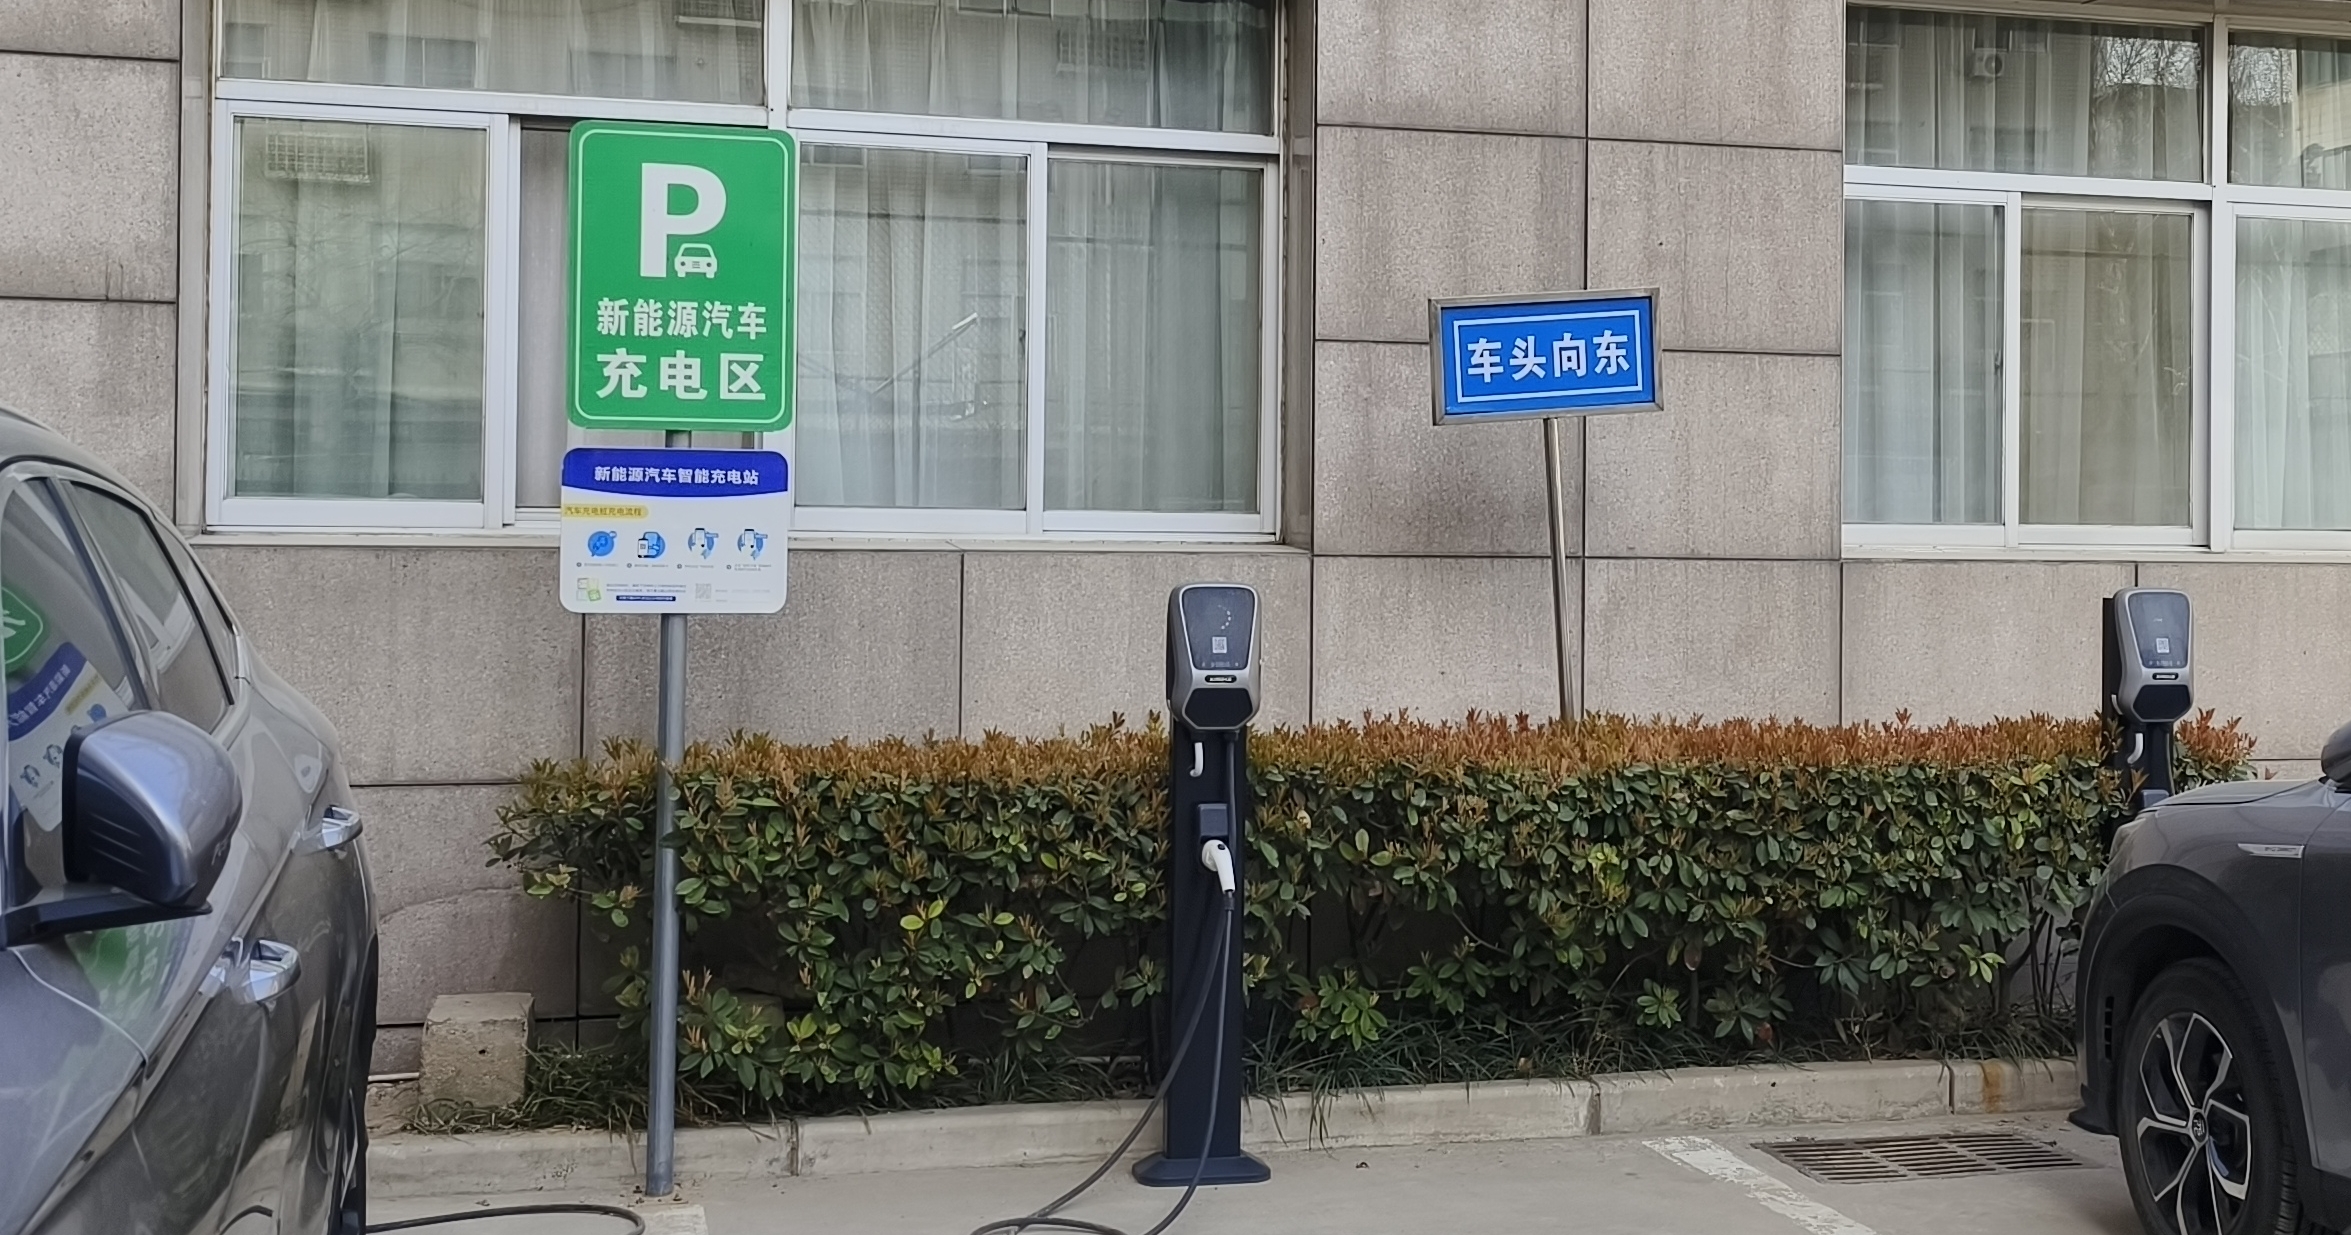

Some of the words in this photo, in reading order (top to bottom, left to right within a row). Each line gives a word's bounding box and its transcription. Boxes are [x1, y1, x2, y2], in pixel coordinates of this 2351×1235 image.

[640, 163, 727, 278] P
[597, 298, 767, 340] 新能源汽车
[596, 348, 766, 400] 充电区
[1467, 329, 1631, 383] 车头向东
[594, 466, 759, 486] 新能源汽车智能充电站
